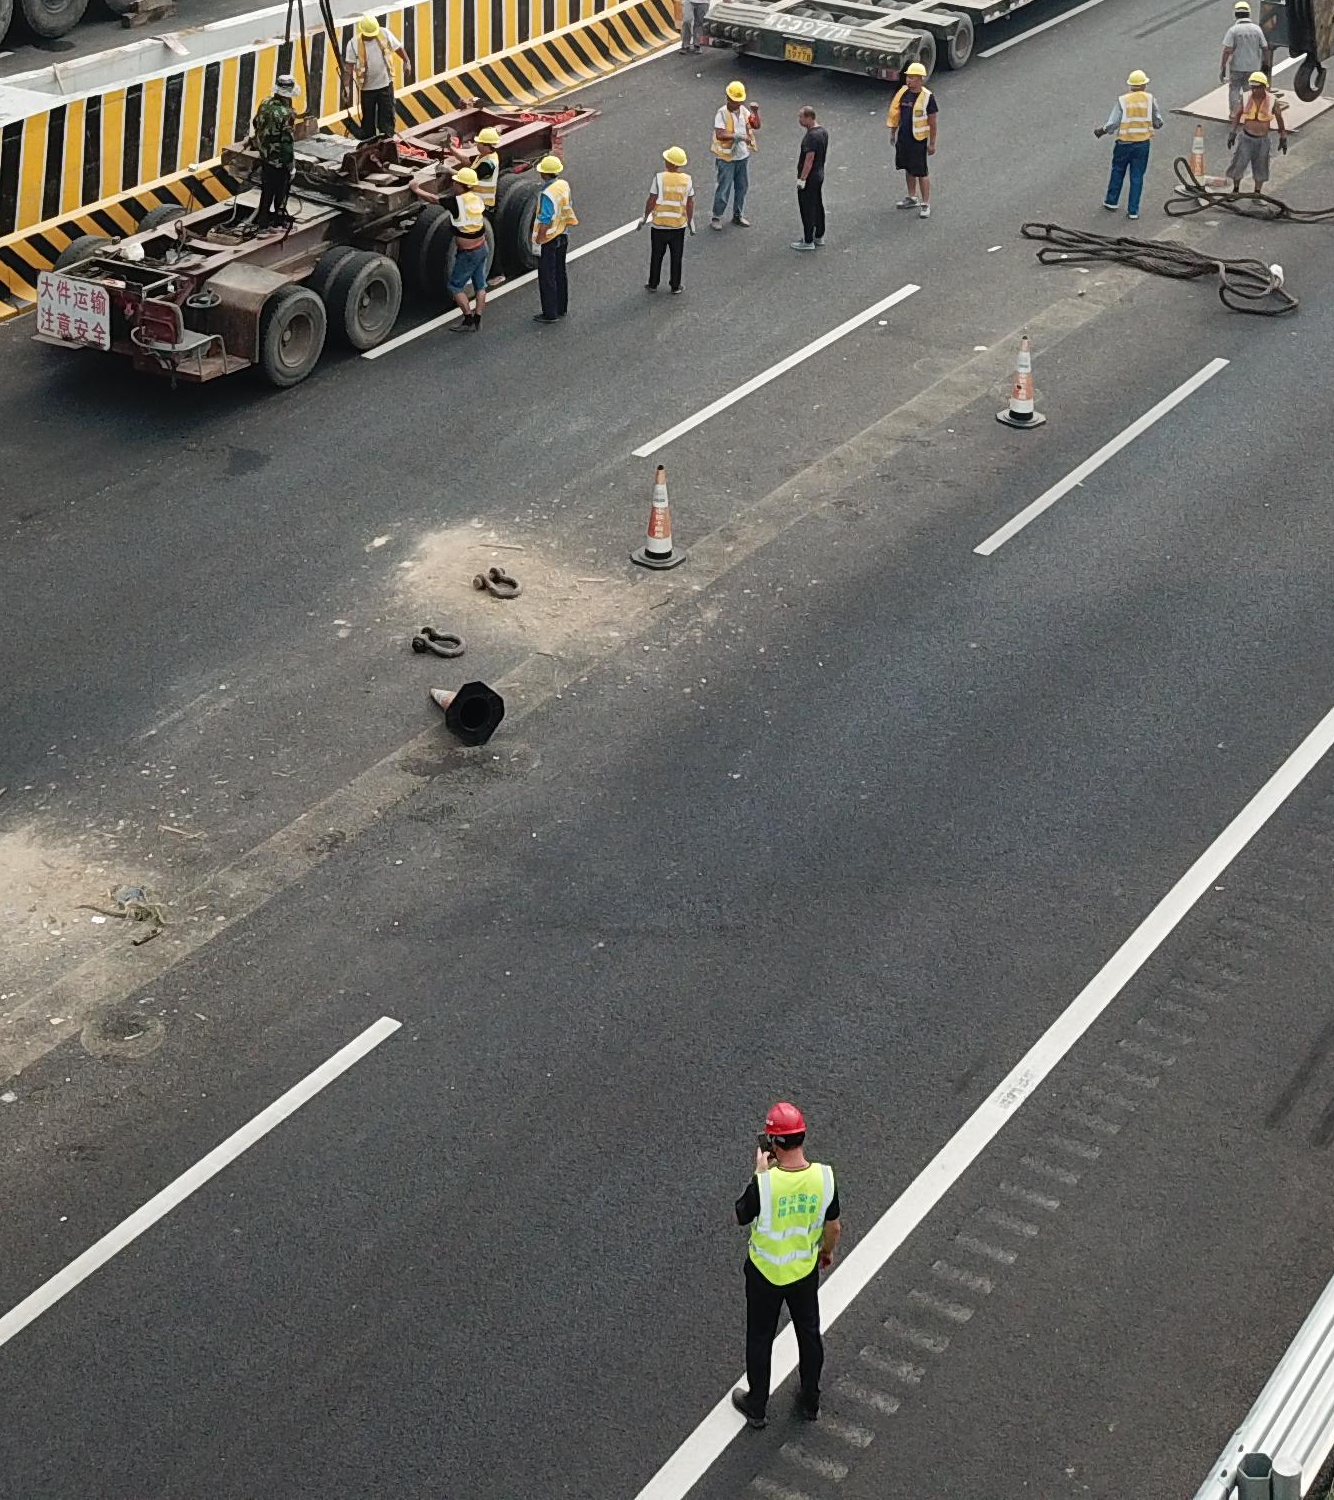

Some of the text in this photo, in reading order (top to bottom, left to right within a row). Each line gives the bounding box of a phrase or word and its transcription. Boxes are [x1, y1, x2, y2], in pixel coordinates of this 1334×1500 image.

[40, 275, 106, 316] 大件运输
[40, 304, 107, 348] 注意安全
